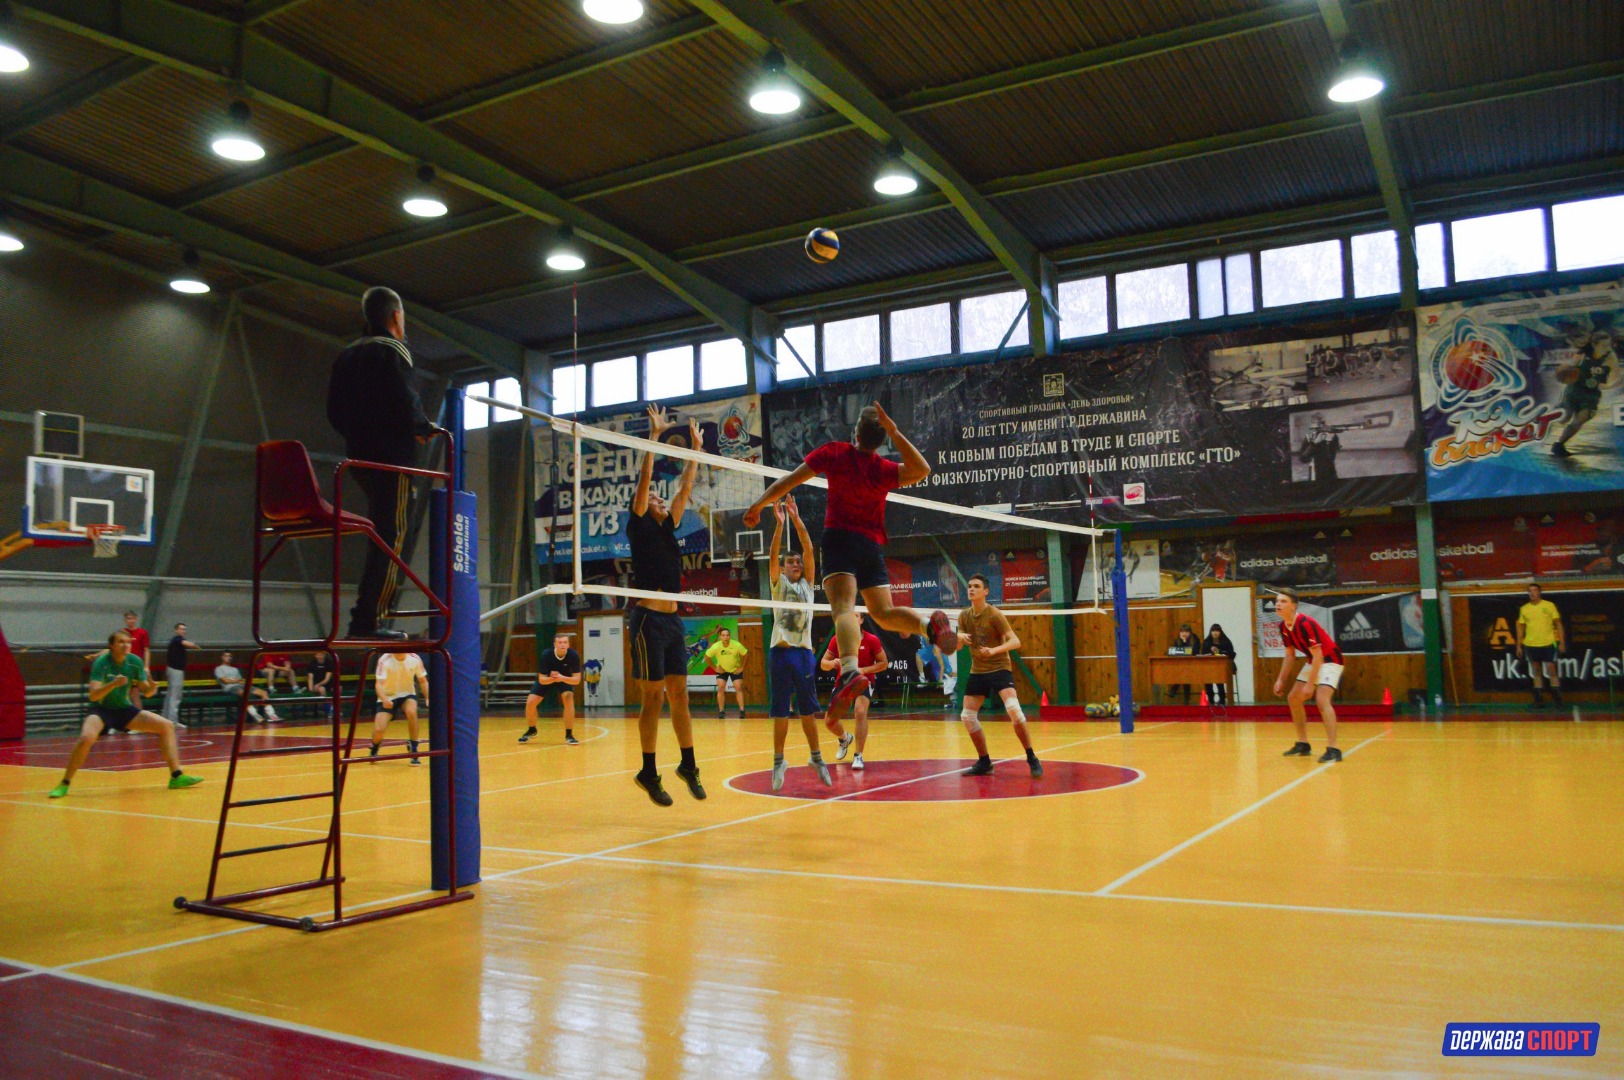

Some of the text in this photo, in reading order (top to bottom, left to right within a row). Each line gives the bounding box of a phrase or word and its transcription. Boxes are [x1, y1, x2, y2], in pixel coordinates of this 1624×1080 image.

[979, 406, 1027, 419] СПОРТИВНЫЙ
[1029, 402, 1066, 414] ПРАЗДНИК
[962, 427, 975, 439] 20
[977, 425, 996, 438] ЛЕТ
[998, 421, 1019, 435] ТГУ
[1021, 418, 1058, 433] ИМЕНИ
[938, 429, 1180, 465] К НОВЫМ ПОБЕДАМ В ТРУДЕ И СПОРТЕ
[932, 455, 1117, 486] ФИЗКУЛЬТУРНО-СПОРТИВНЫЙ
[1121, 451, 1195, 470] КОМПЛЕКС
[1199, 446, 1241, 463] «ГТО»
[559, 480, 667, 509] В КАЖДМ
[588, 512, 619, 537] ИЗ
[454, 513, 463, 572] Schelde
[1370, 542, 1493, 561] adidas sketball
[1240, 554, 1327, 568] adidas basketball
[1340, 628, 1380, 641] adidas
[1492, 649, 1624, 680] vk.m/as
